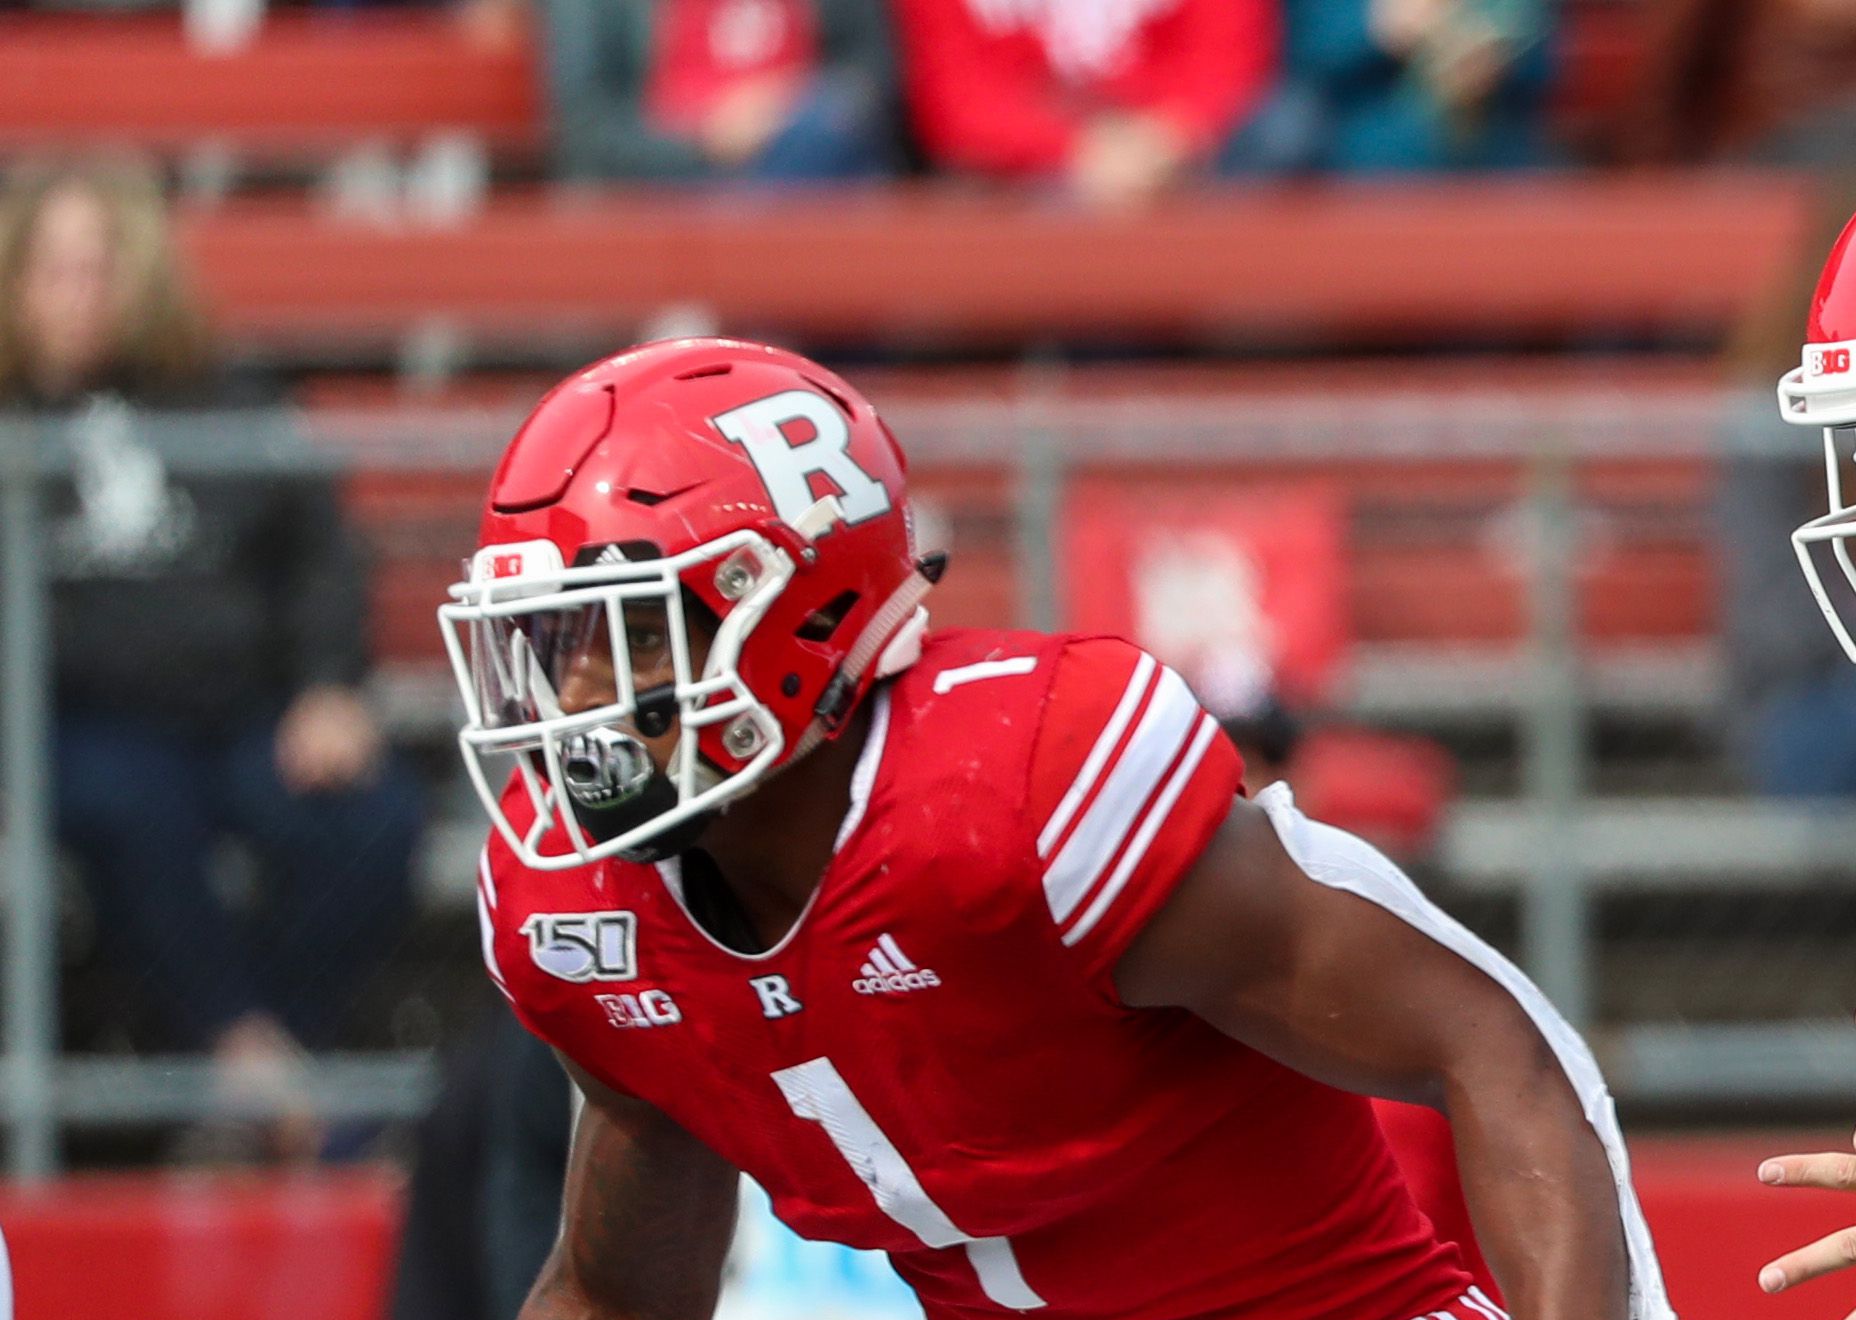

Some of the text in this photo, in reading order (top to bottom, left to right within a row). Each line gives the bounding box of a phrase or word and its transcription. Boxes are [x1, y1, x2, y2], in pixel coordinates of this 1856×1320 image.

[710, 390, 890, 533] R
[750, 973, 802, 1020] R
[852, 967, 941, 996] adidas
[770, 1056, 1048, 1313] 1
